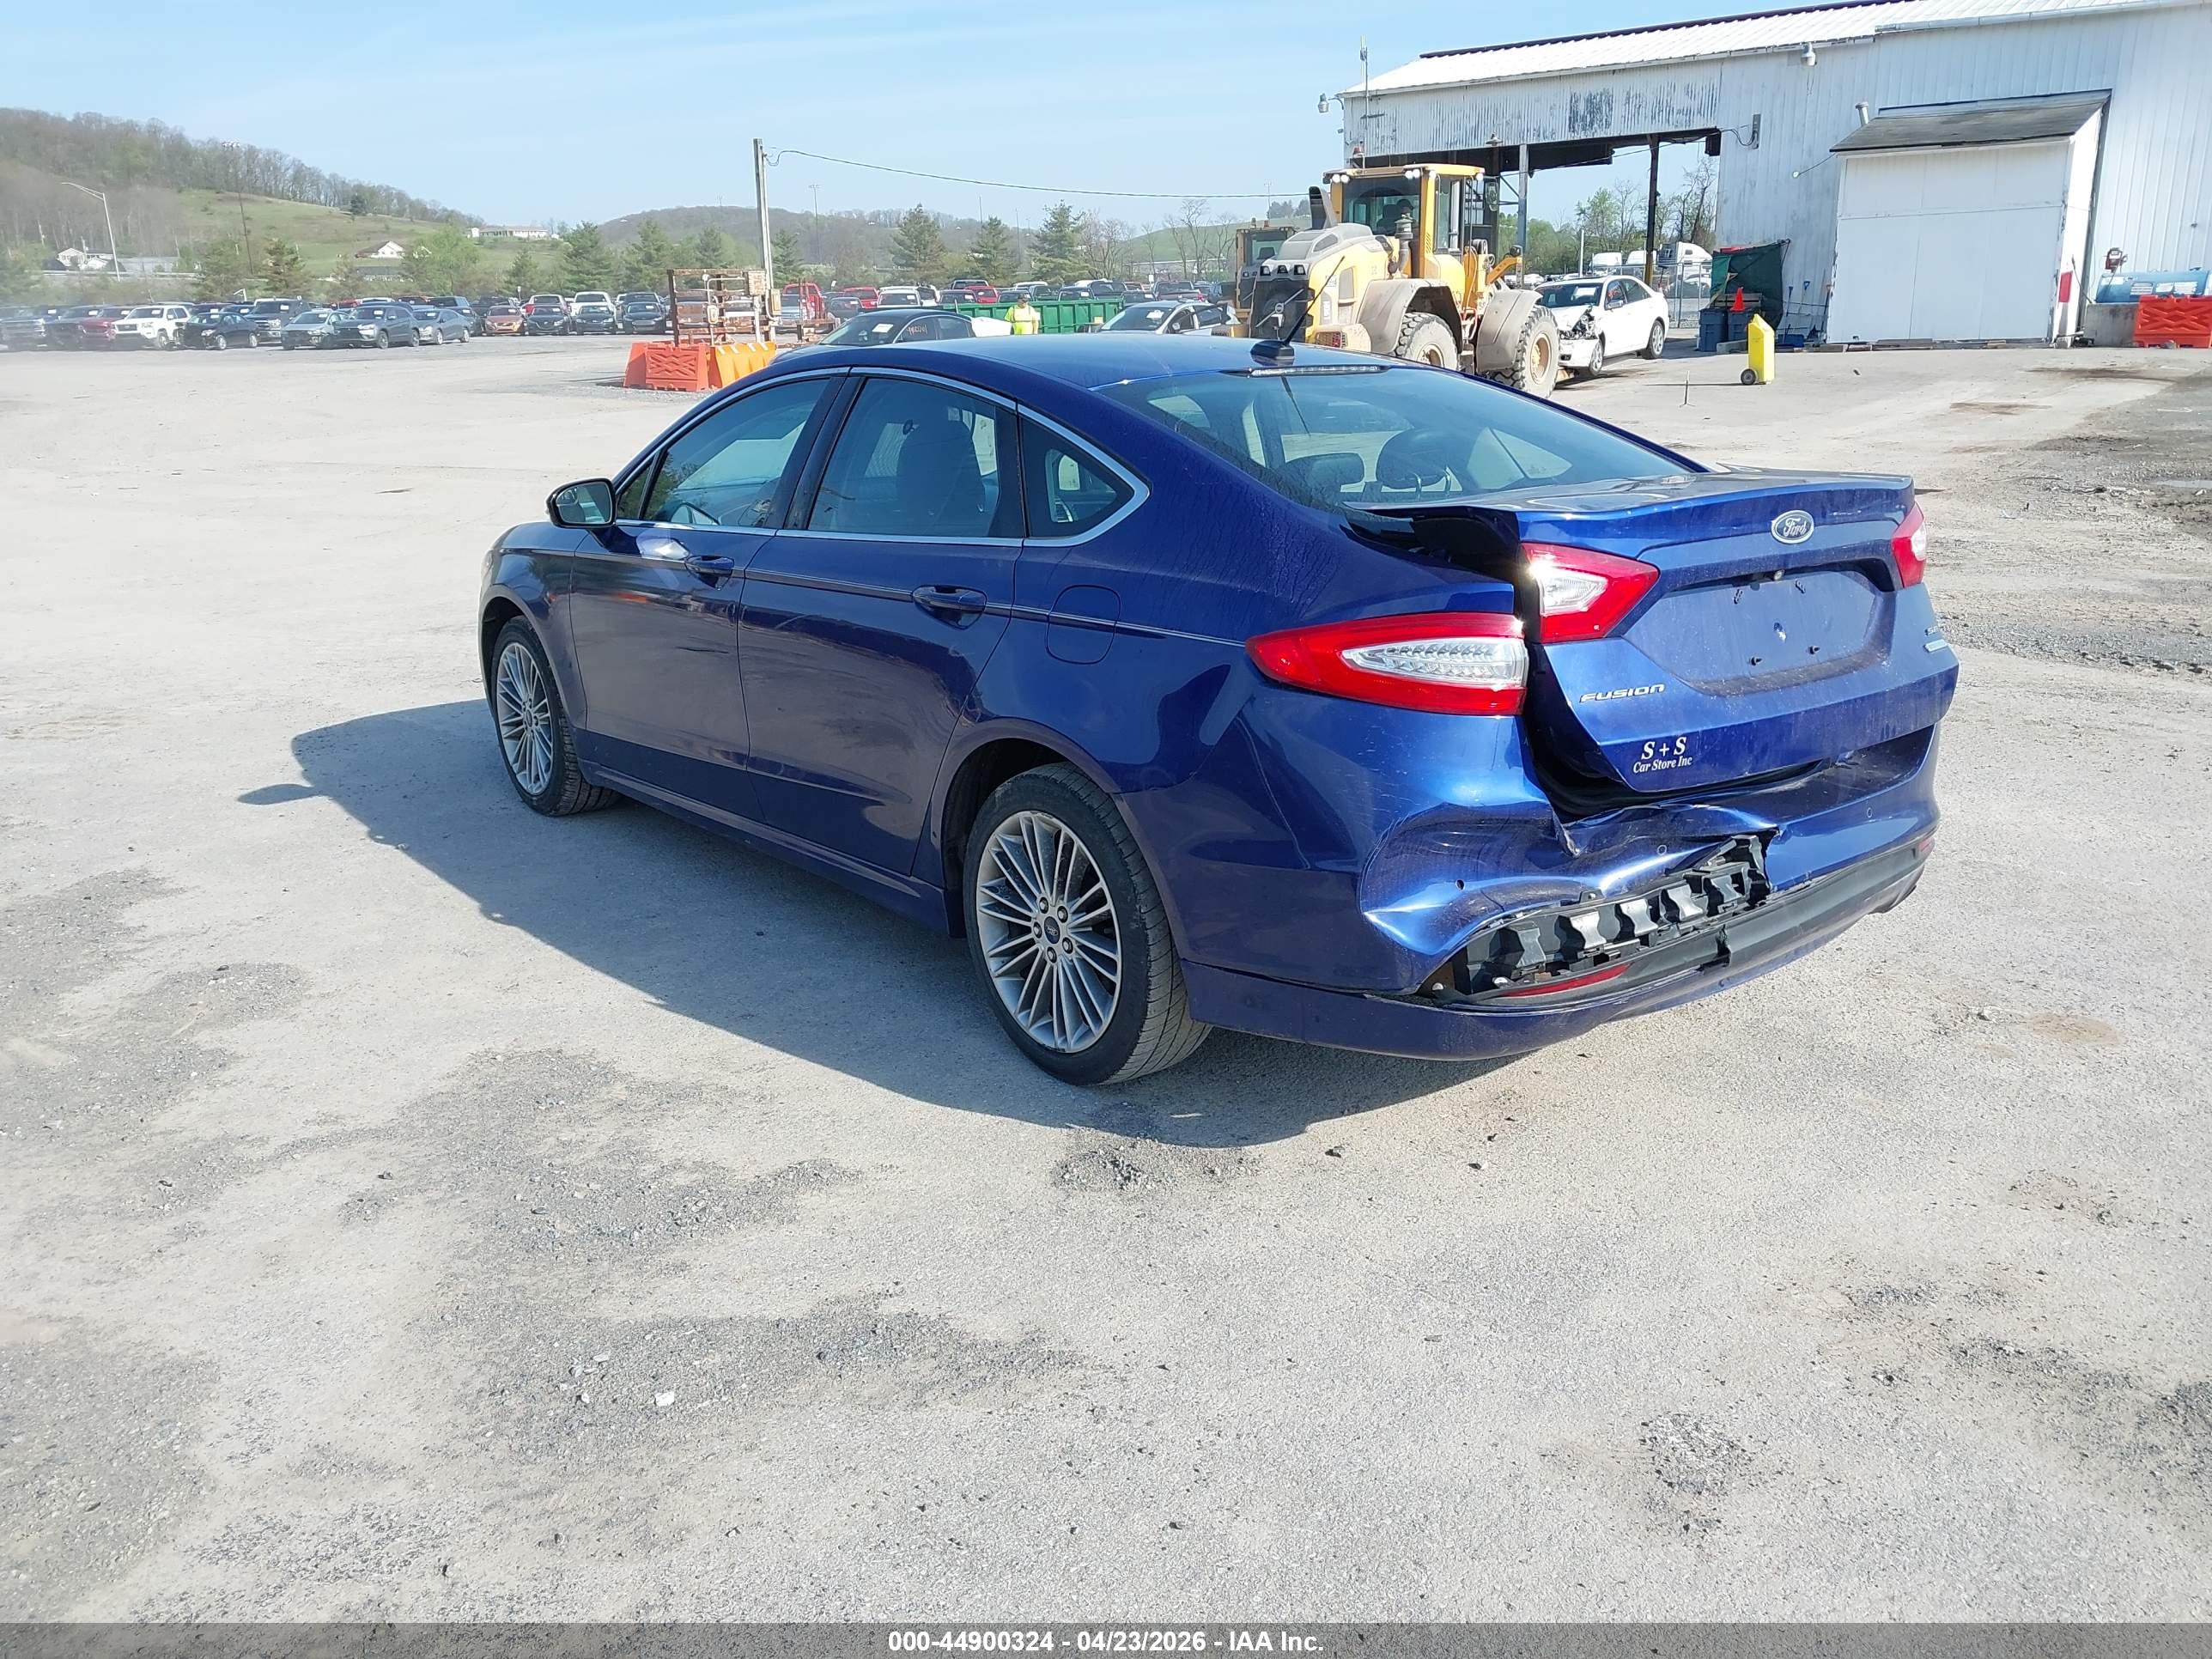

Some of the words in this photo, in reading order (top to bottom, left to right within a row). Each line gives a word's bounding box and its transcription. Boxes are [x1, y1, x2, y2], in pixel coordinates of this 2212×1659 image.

[1783, 517, 1808, 537] Ford
[1579, 684, 1666, 703] FUSION
[1641, 740, 1656, 760] S
[1658, 743, 1670, 757] +
[1673, 736, 1687, 756] S
[1632, 762, 1651, 774] Car
[1651, 759, 1676, 771] Store
[1677, 756, 1692, 768] Inc
